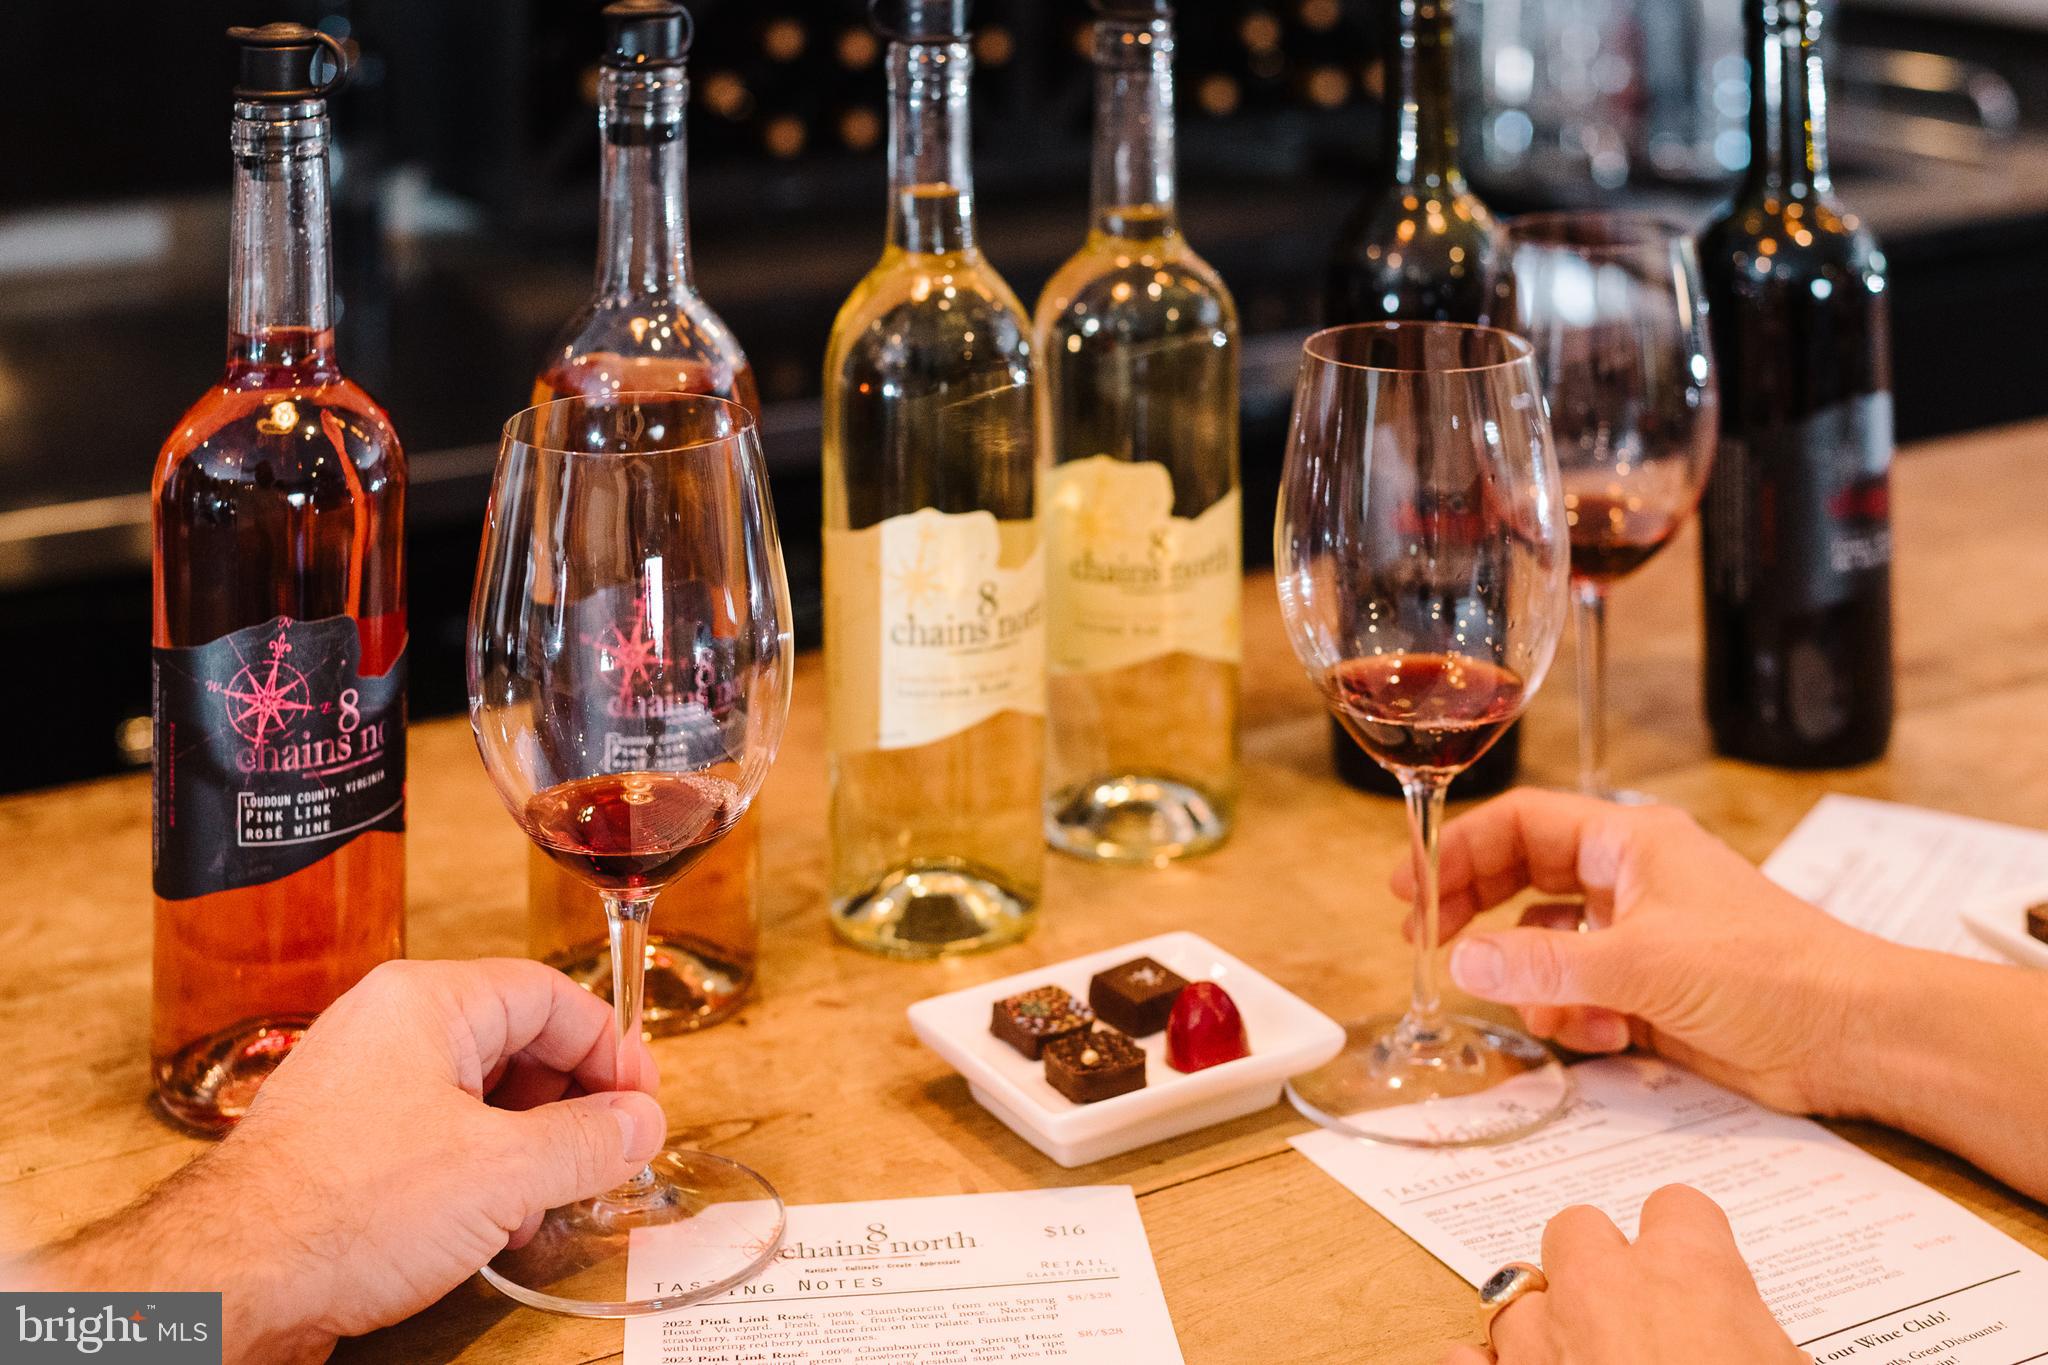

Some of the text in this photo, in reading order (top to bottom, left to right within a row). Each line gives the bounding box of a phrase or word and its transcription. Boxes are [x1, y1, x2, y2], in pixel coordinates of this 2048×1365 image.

[977, 581, 999, 618] 8
[891, 613, 990, 647] chains
[338, 688, 361, 734] 8
[235, 731, 352, 774] chains
[781, 1231, 977, 1259] chains north
[866, 1222, 888, 1242] 8
[1044, 1224, 1085, 1239] $16
[662, 1319, 692, 1328] 2022
[700, 1317, 730, 1325] Pink
[739, 1315, 769, 1323] Link
[823, 1310, 853, 1319] 100%
[861, 1303, 945, 1316] Chambourcin
[952, 1302, 981, 1310] from
[1016, 1297, 1056, 1306] Spring
[663, 1328, 701, 1336] House
[1000, 1306, 1034, 1314] Notes
[1045, 1303, 1057, 1311] of
[735, 1332, 791, 1342] raspberry
[796, 1329, 818, 1337] and
[824, 1327, 855, 1335] stone
[860, 1325, 886, 1333] fruit
[890, 1323, 907, 1331] on
[911, 1321, 930, 1329] the
[979, 1315, 1026, 1324] Finishes
[1031, 1312, 1059, 1322] crisp
[662, 1356, 692, 1364] 2023
[698, 1354, 729, 1362] Pink
[735, 1353, 766, 1361] Link
[821, 1347, 852, 1356] 100%
[858, 1340, 941, 1353] Chambourcin
[980, 1335, 1021, 1345] Spring
[1025, 1332, 1063, 1341] House
[663, 1344, 688, 1352] with
[692, 1343, 745, 1353] lingering
[750, 1341, 768, 1349] red
[772, 1338, 804, 1348] berry
[855, 1351, 918, 1362] strawberry
[970, 1345, 1006, 1354] opens
[1042, 1340, 1065, 1349] ripe
[1827, 1345, 1858, 1361] our
[1853, 1330, 1904, 1350] Wine
[1903, 1311, 1951, 1333] Club!
[1908, 1344, 1945, 1361] Great
[1942, 1321, 2009, 1349] Discounts!
[1010, 1351, 1041, 1360] gives
